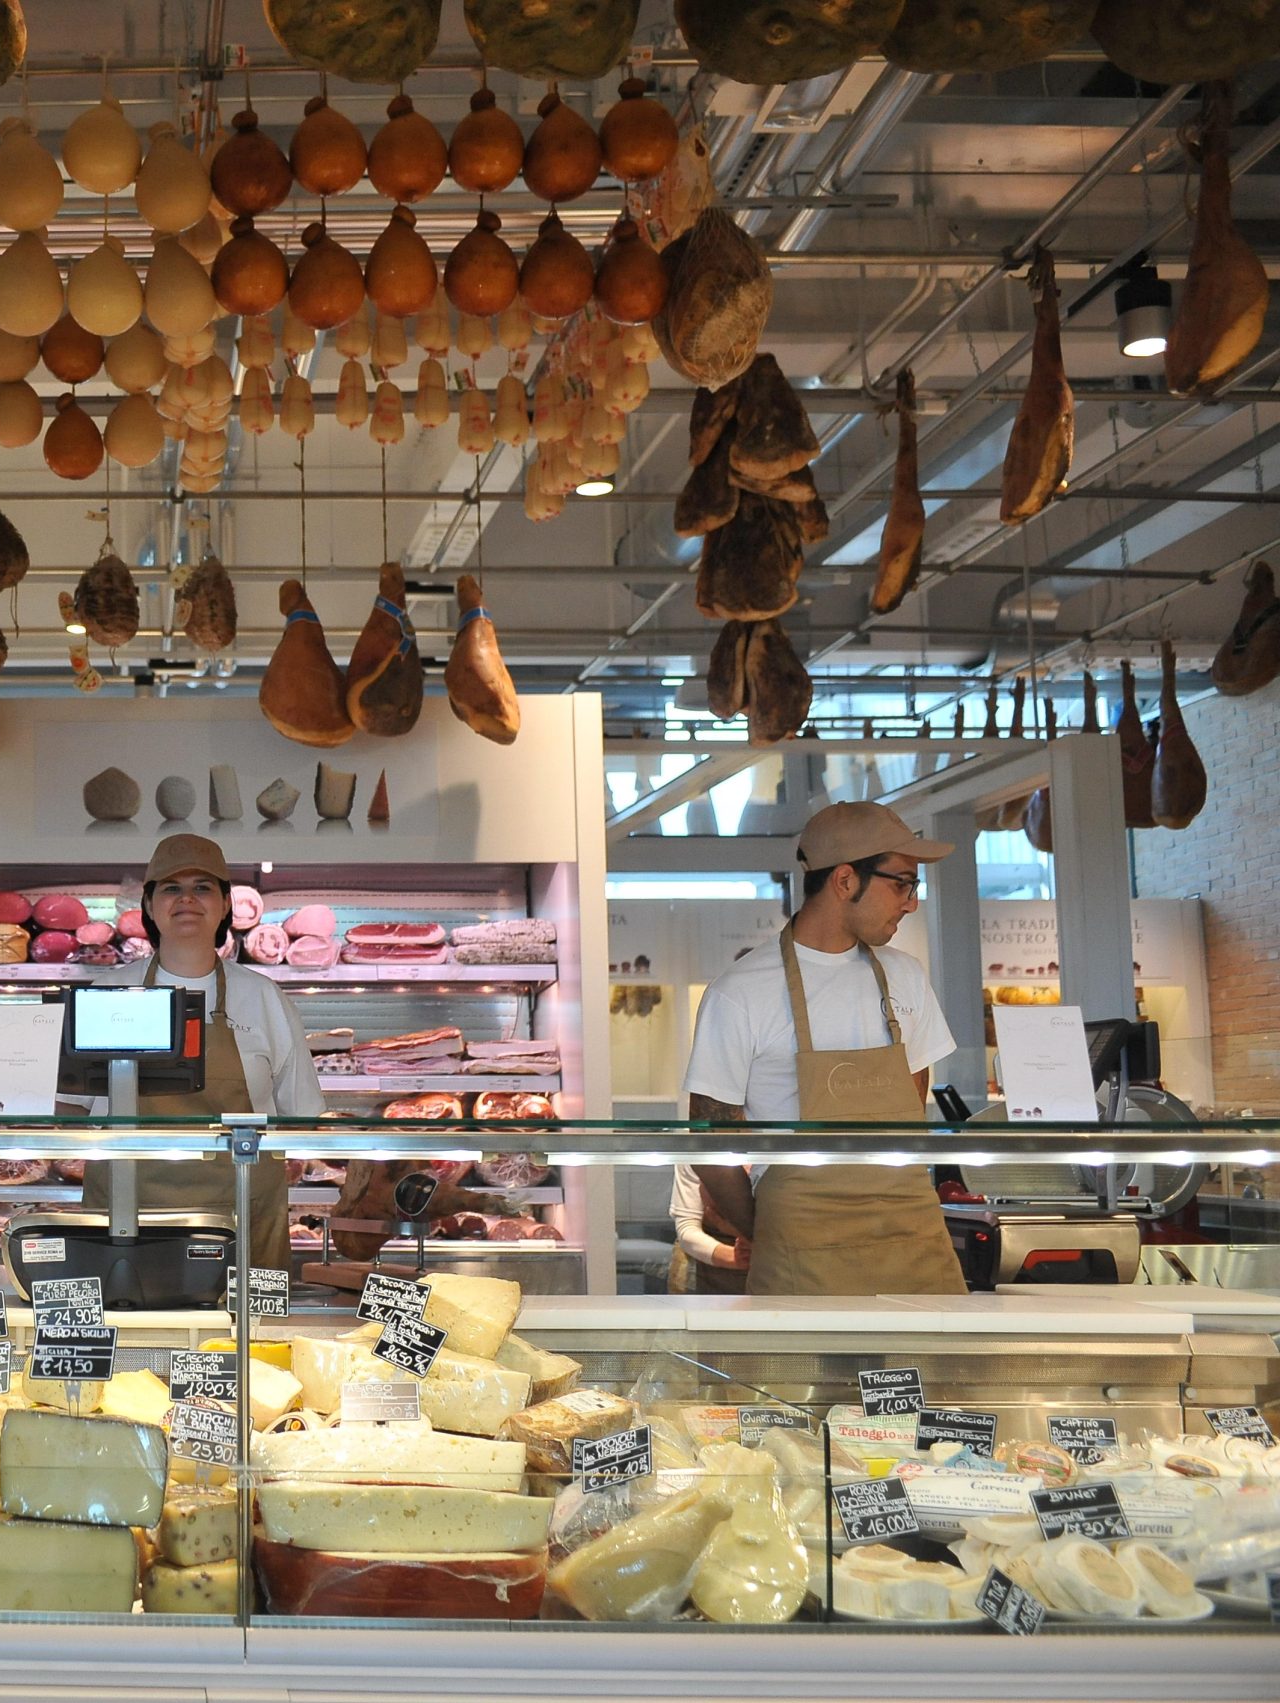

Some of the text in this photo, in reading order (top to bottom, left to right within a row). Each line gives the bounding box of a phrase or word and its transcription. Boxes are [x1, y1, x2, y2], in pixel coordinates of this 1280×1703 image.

[982, 919, 1000, 930] LA
[982, 933, 1047, 944] NOSTRO
[229, 1023, 252, 1032] TALY
[47, 1282, 78, 1292] PESTO
[43, 1289, 98, 1301] PURA PECORA
[42, 1328, 70, 1338] NERO
[179, 1407, 236, 1429] PISTACCHI
[214, 1424, 237, 1434] PECO
[839, 1425, 896, 1440] Taleggio
[596, 1430, 636, 1449] PROVOLA
[849, 1481, 888, 1496] ROBIOLA
[971, 1481, 1021, 1494] Carena
[840, 1493, 886, 1509] BOSINA
